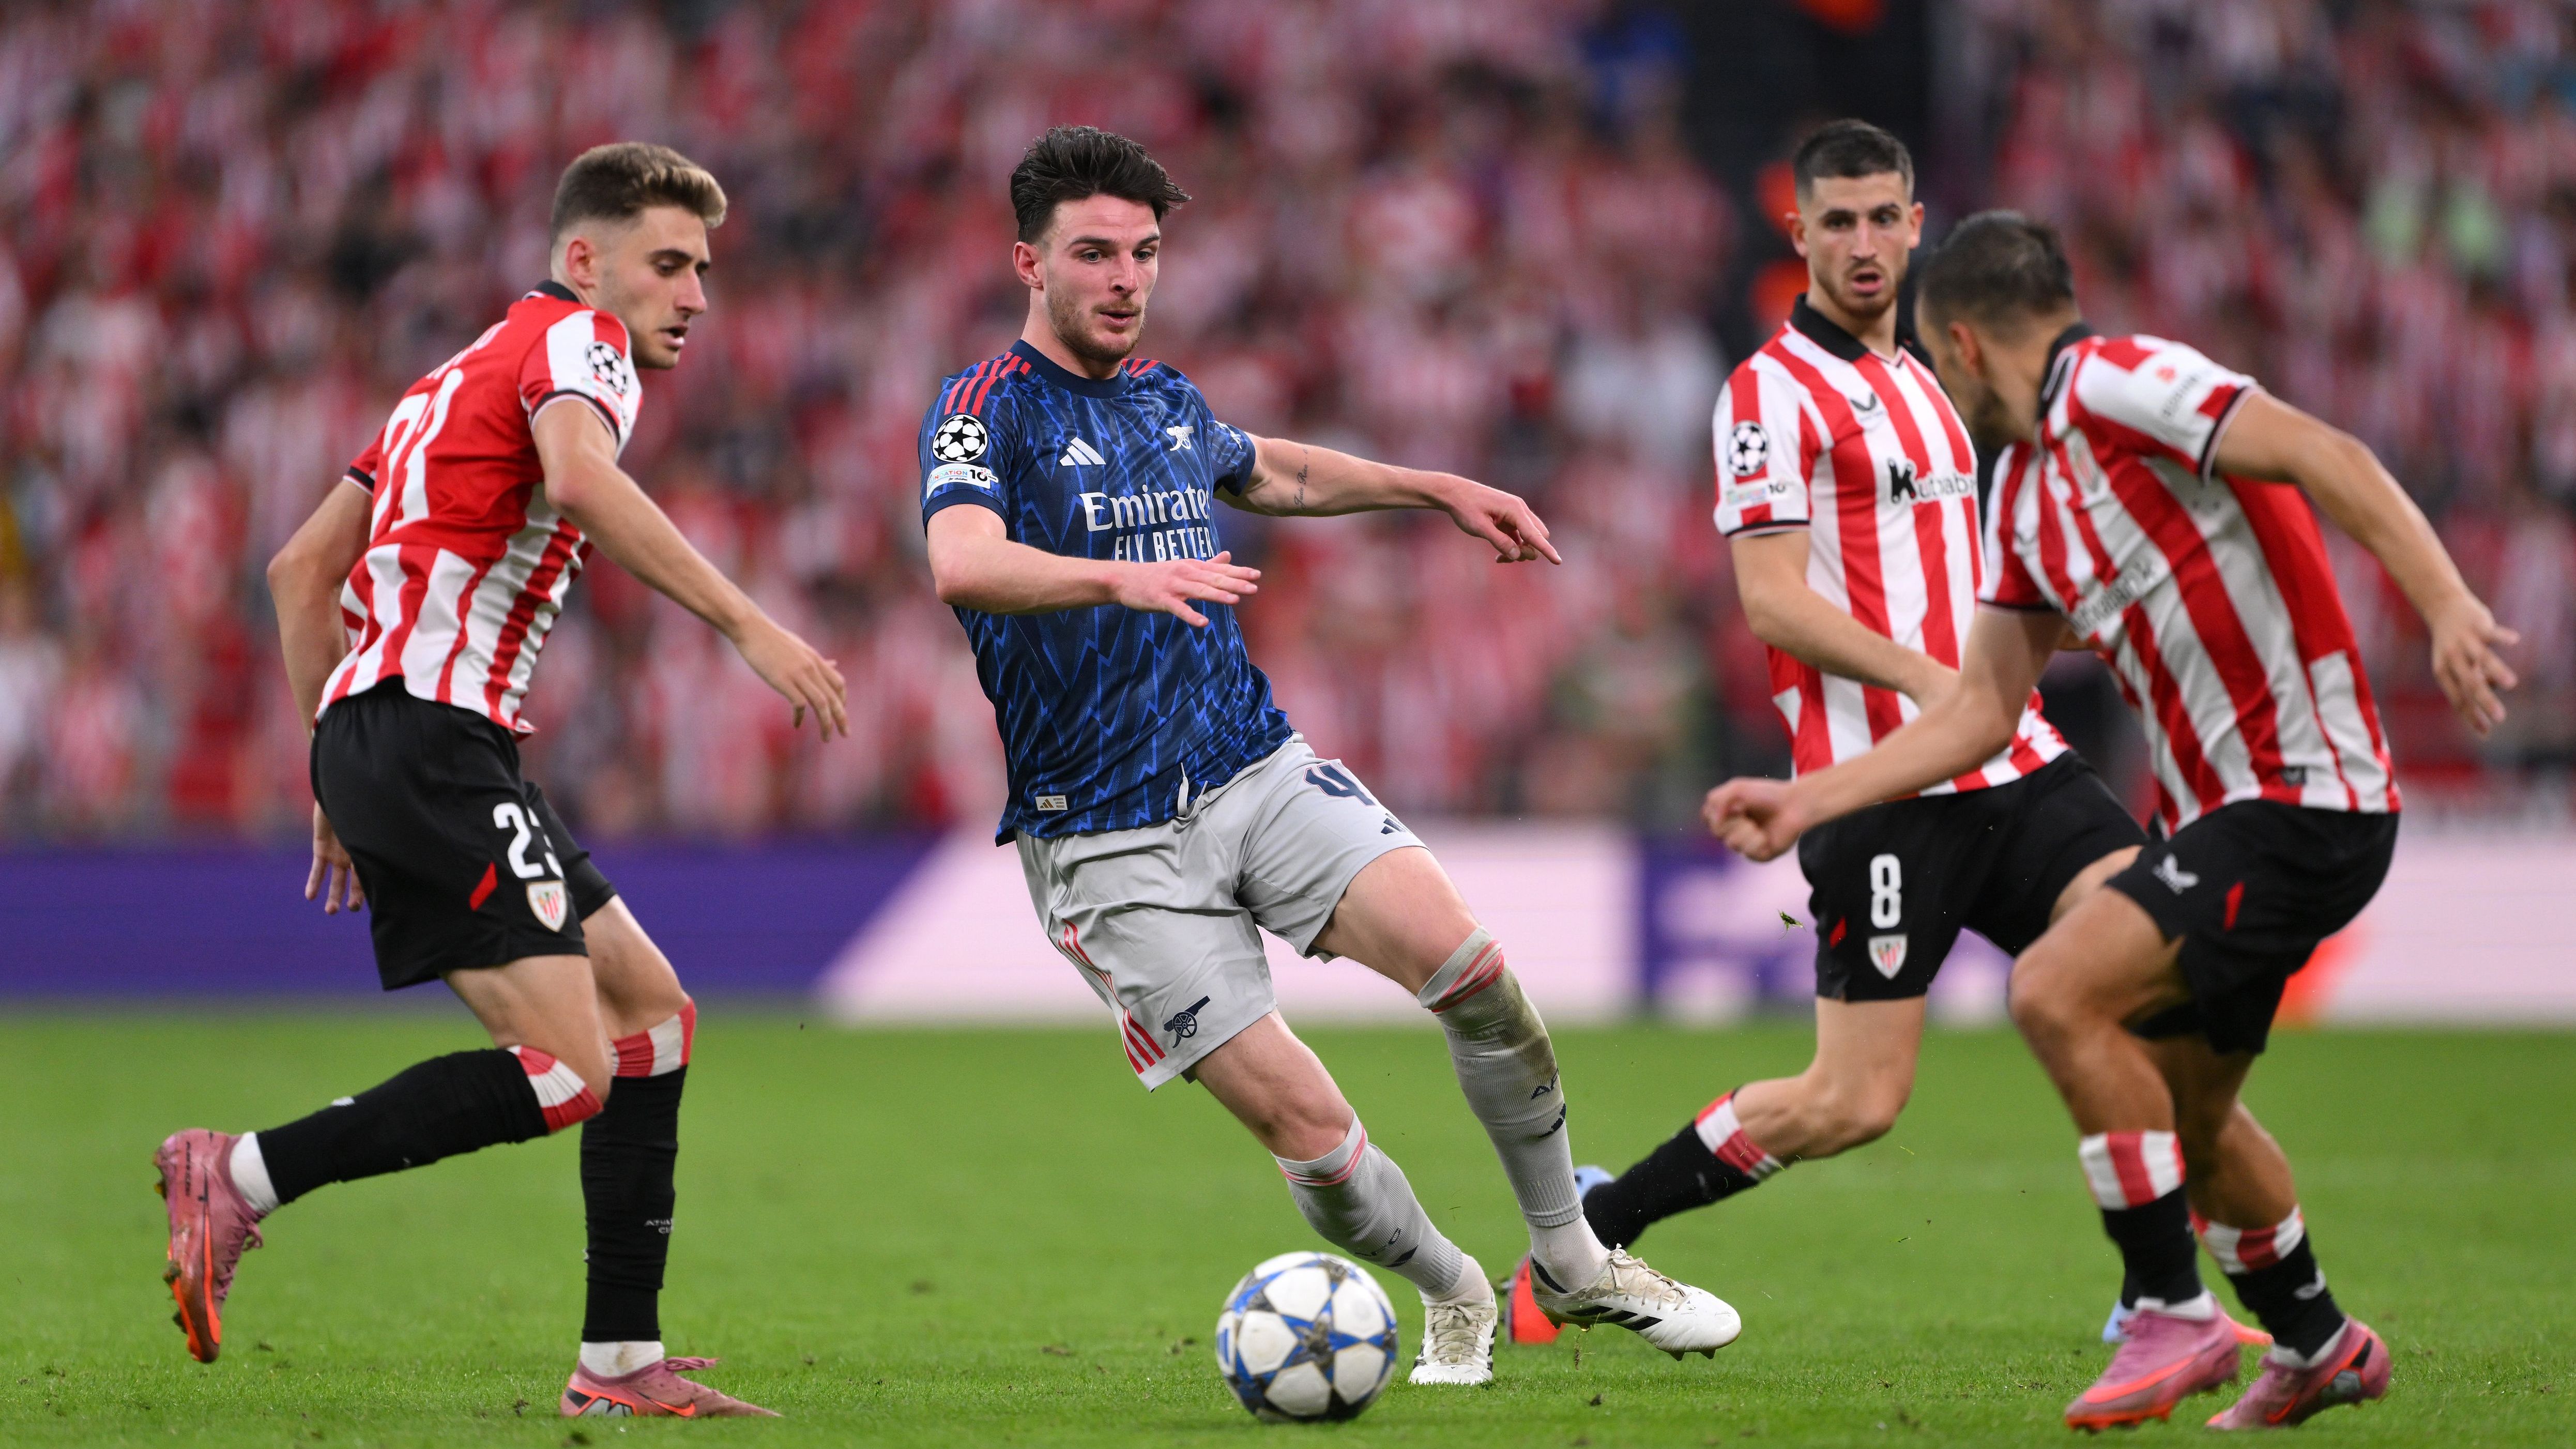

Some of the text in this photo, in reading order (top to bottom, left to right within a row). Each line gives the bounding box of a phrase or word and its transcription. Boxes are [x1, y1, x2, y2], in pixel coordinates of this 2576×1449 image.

[969, 469, 988, 481] 10
[1153, 527, 1214, 562] BETTER
[1303, 764, 1376, 806] 4
[1870, 853, 1902, 929] 8
